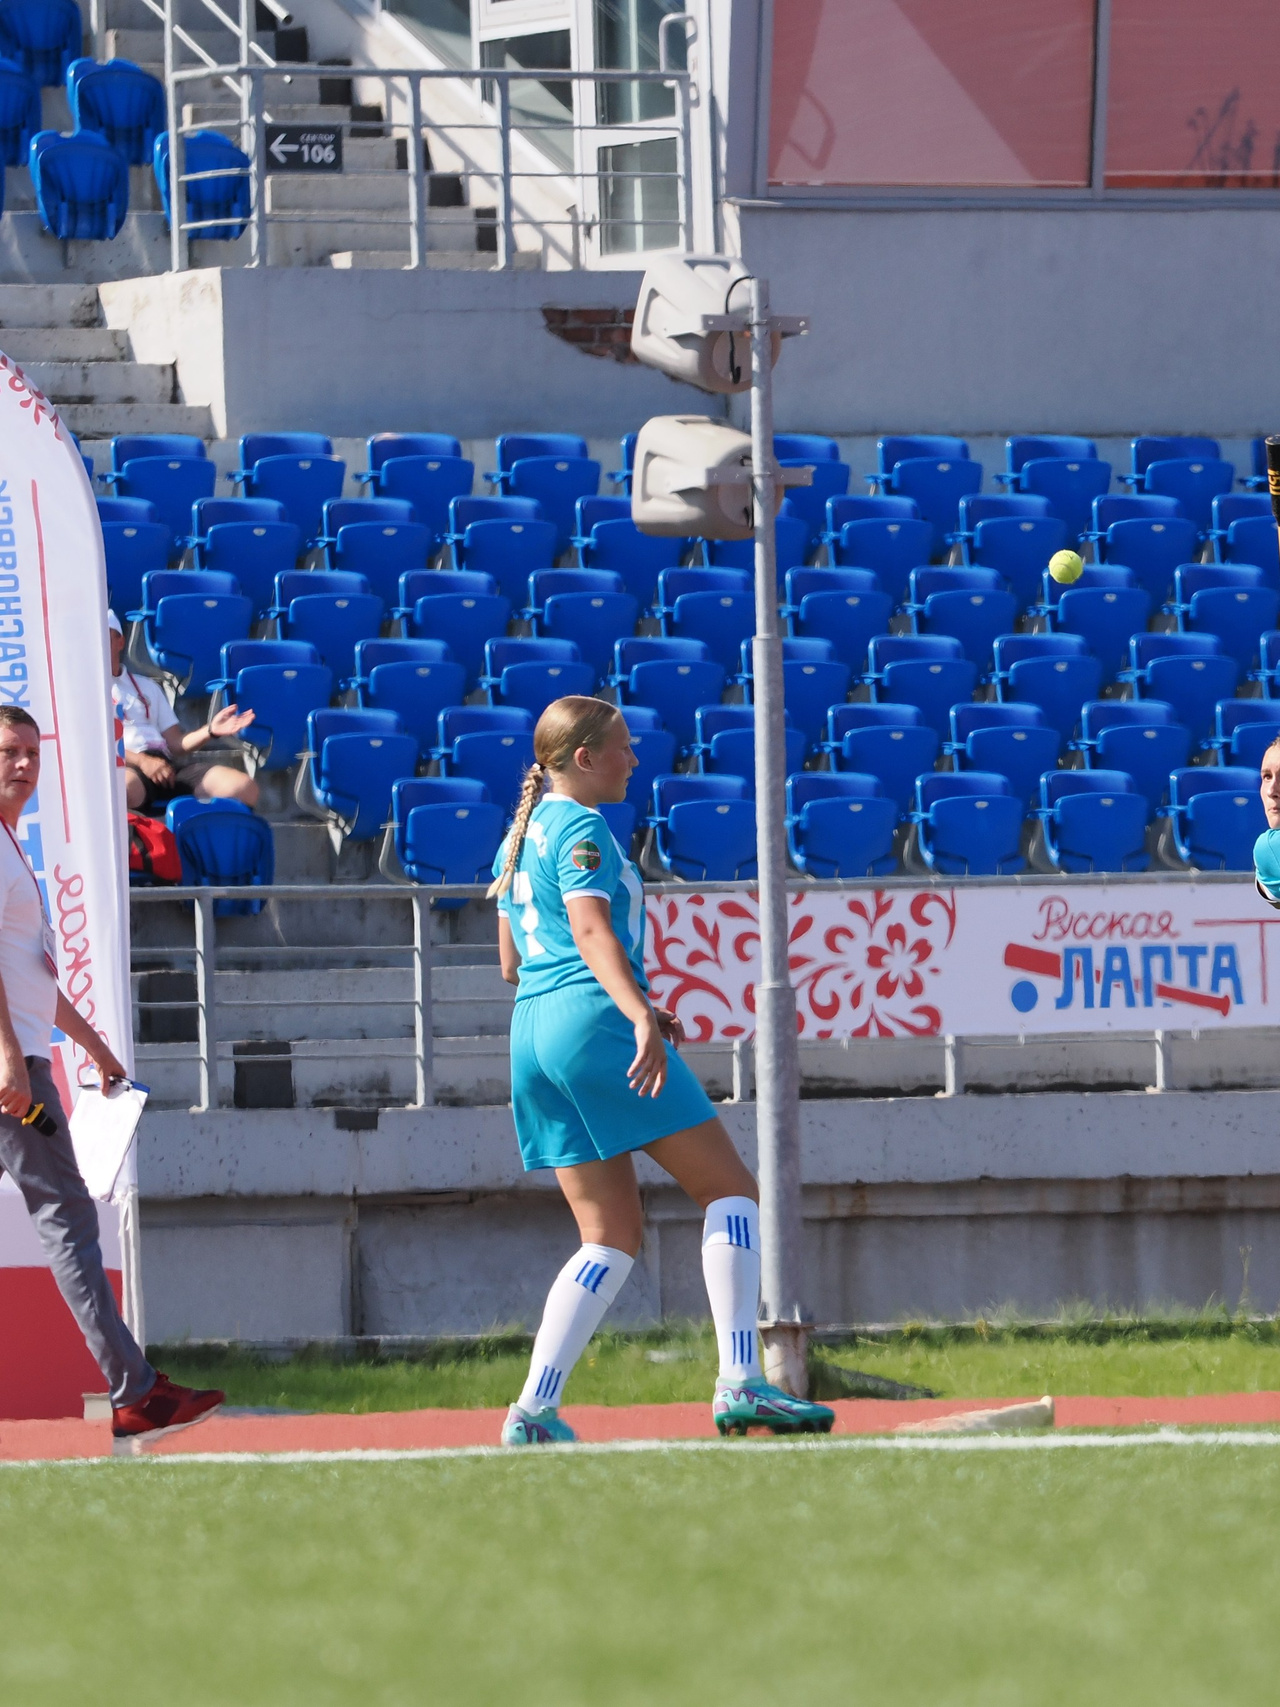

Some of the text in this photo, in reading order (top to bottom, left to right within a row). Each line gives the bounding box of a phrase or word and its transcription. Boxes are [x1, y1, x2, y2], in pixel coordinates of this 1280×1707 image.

[301, 144, 336, 163] 106
[1033, 896, 1181, 941] Русская
[1055, 944, 1245, 1009] ЛАПТА
